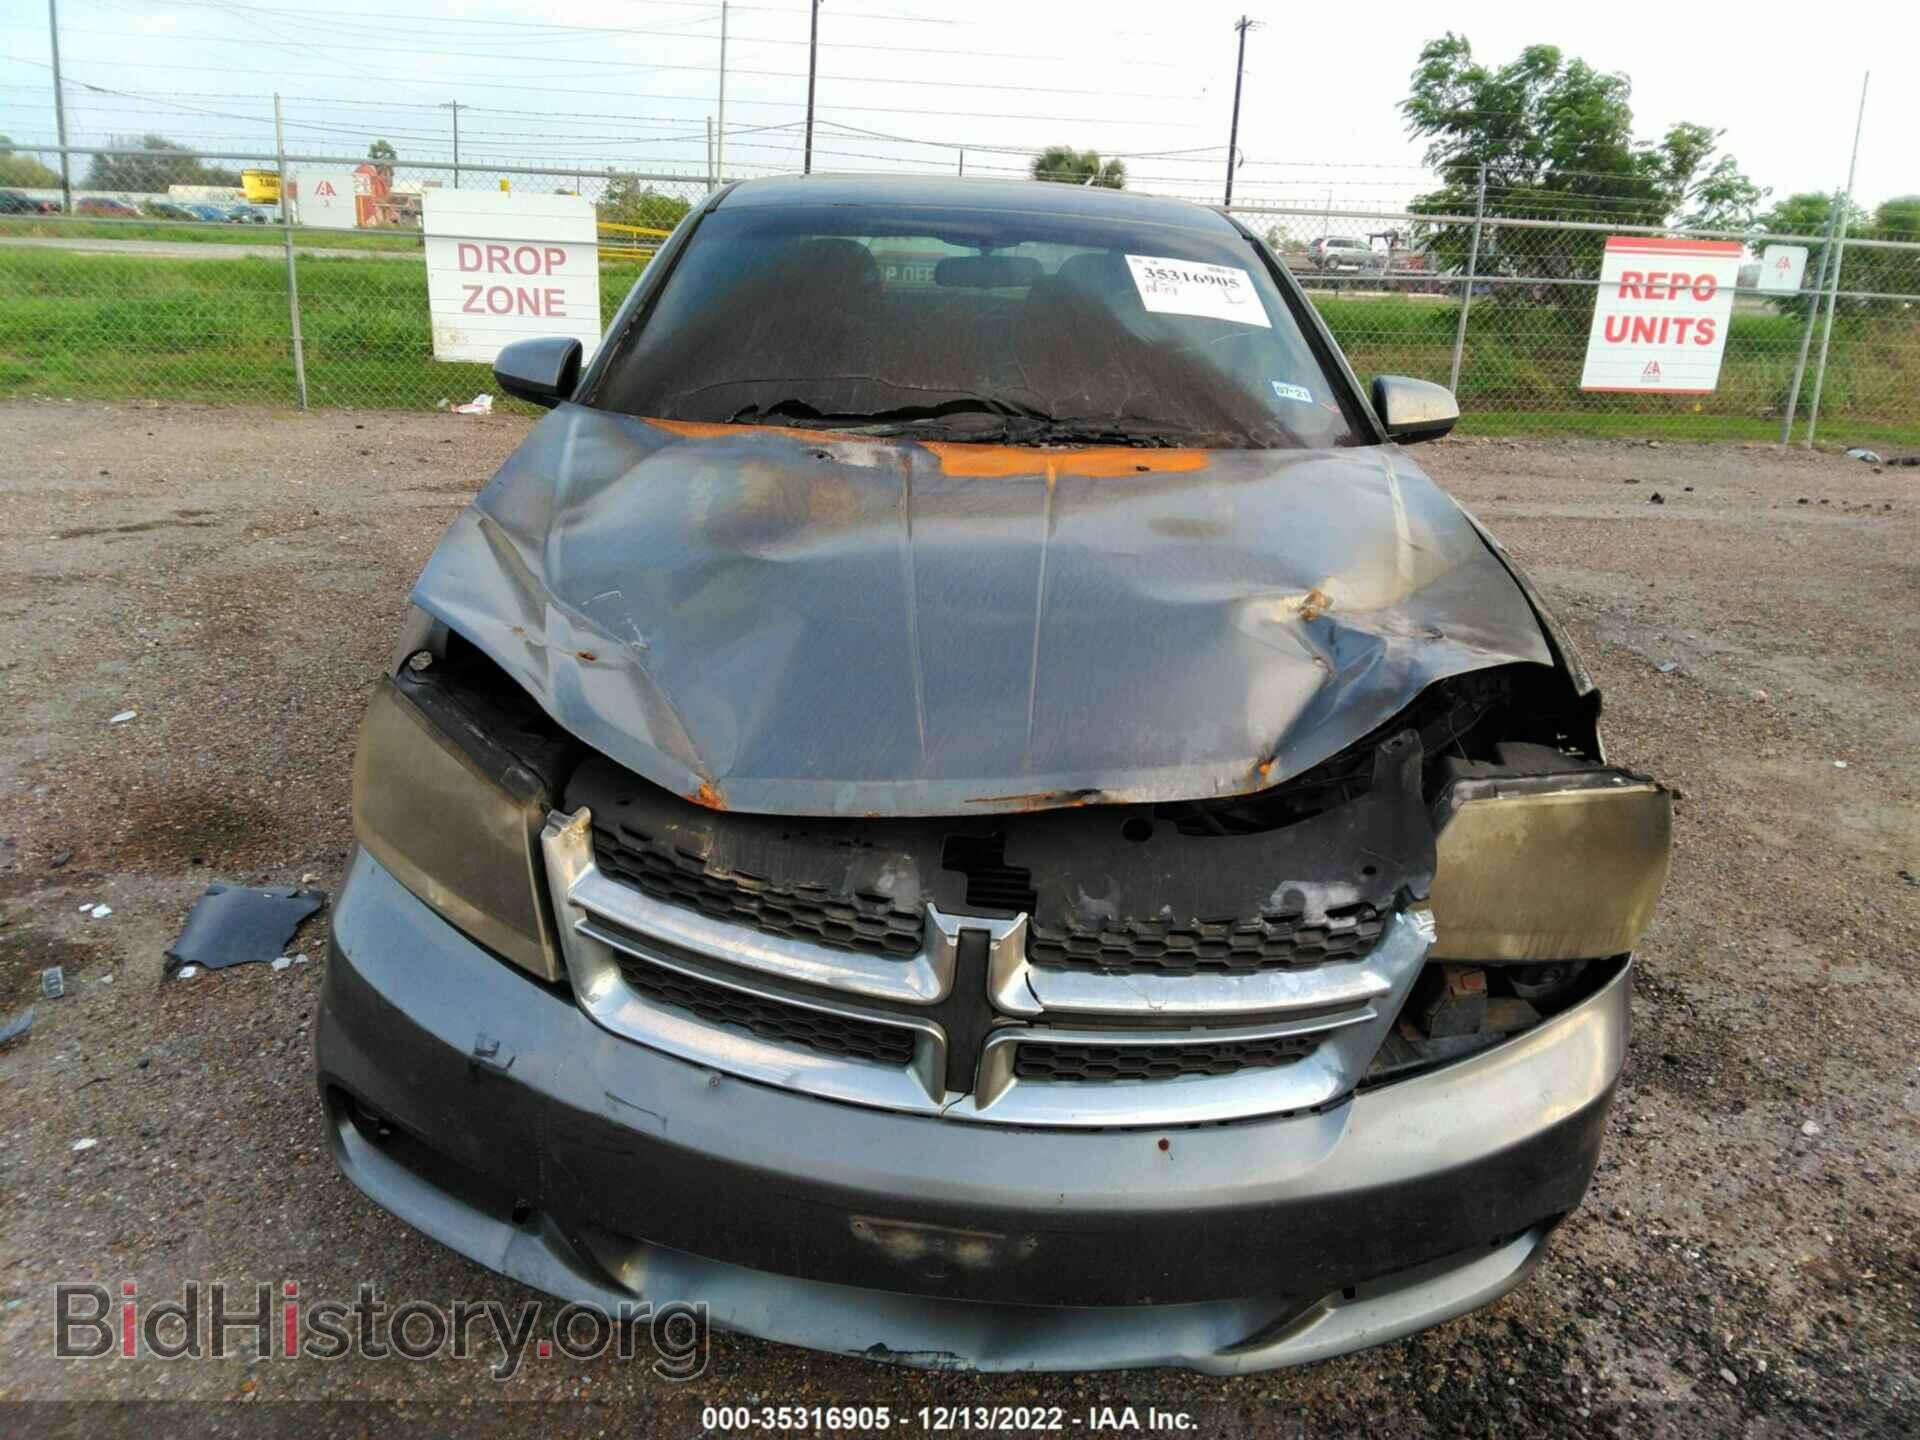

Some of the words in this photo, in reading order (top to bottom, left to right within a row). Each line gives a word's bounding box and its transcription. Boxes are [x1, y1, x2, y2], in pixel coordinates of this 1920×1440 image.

[457, 243, 567, 276] DROP
[1144, 267, 1241, 289] 35316905
[1618, 271, 1718, 302] REPO
[462, 284, 567, 317] ZONE
[1603, 315, 1717, 346] UNITS
